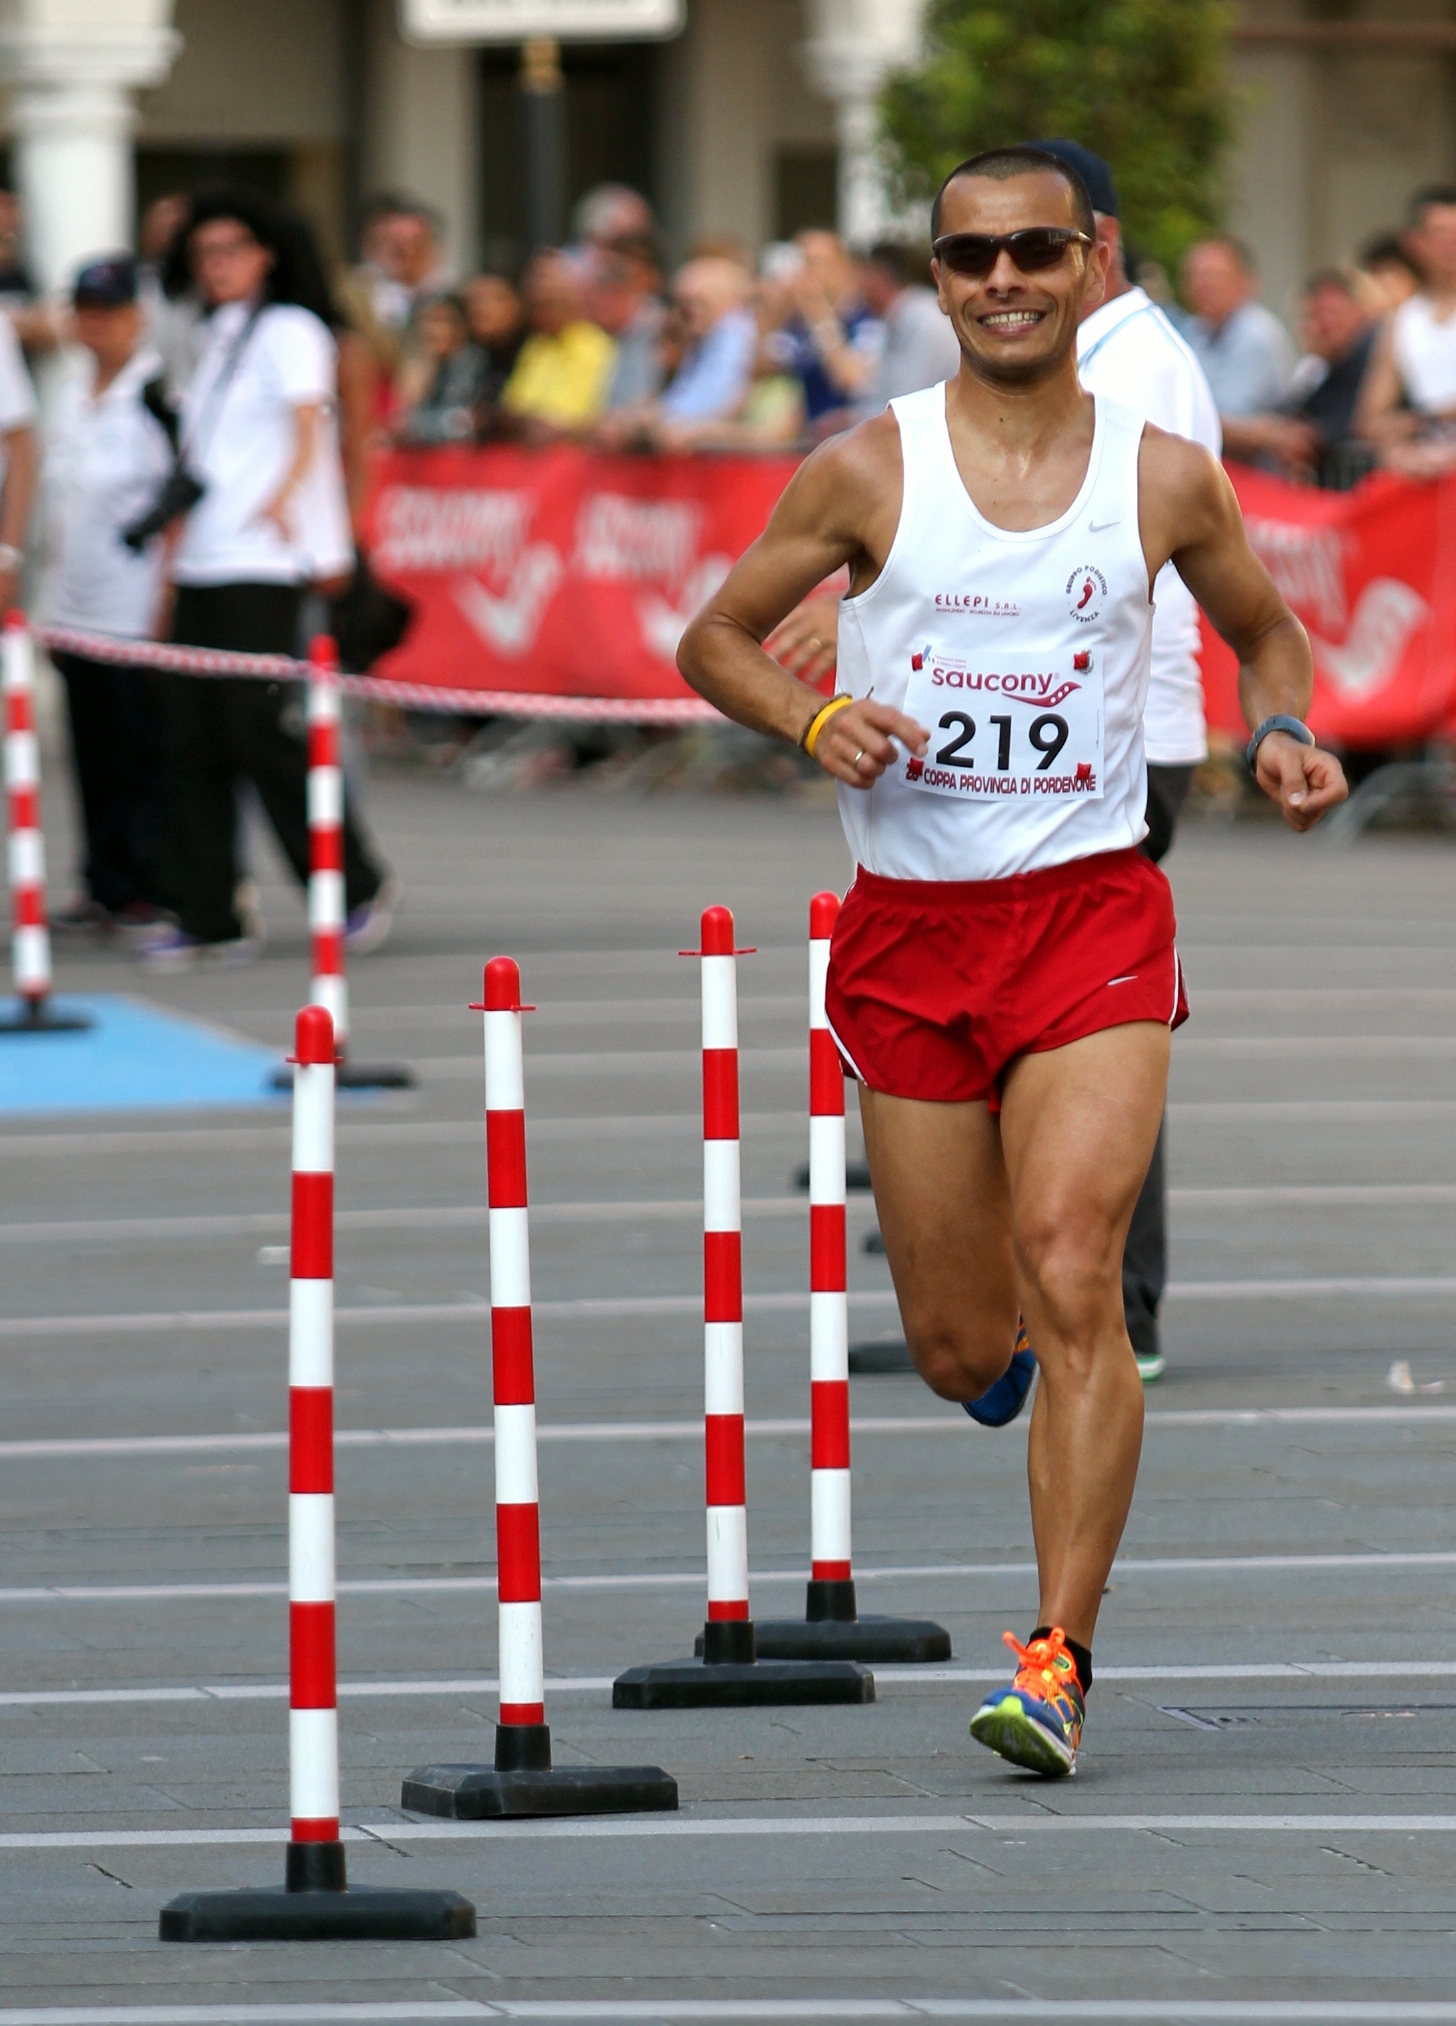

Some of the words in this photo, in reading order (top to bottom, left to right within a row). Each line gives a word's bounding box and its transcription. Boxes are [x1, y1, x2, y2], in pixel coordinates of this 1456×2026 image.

[1066, 567, 1083, 595] GRUPPO
[1085, 564, 1108, 596] PODISTICO
[935, 593, 989, 609] ELLEPI
[1070, 609, 1099, 623] LIVENZA
[931, 666, 1054, 696] saucony
[936, 709, 1069, 771] 219
[924, 768, 957, 791] COPPA
[959, 774, 1018, 795] PROVINCIA
[1021, 776, 1031, 795] DI
[1033, 774, 1097, 795] PORDENONE
